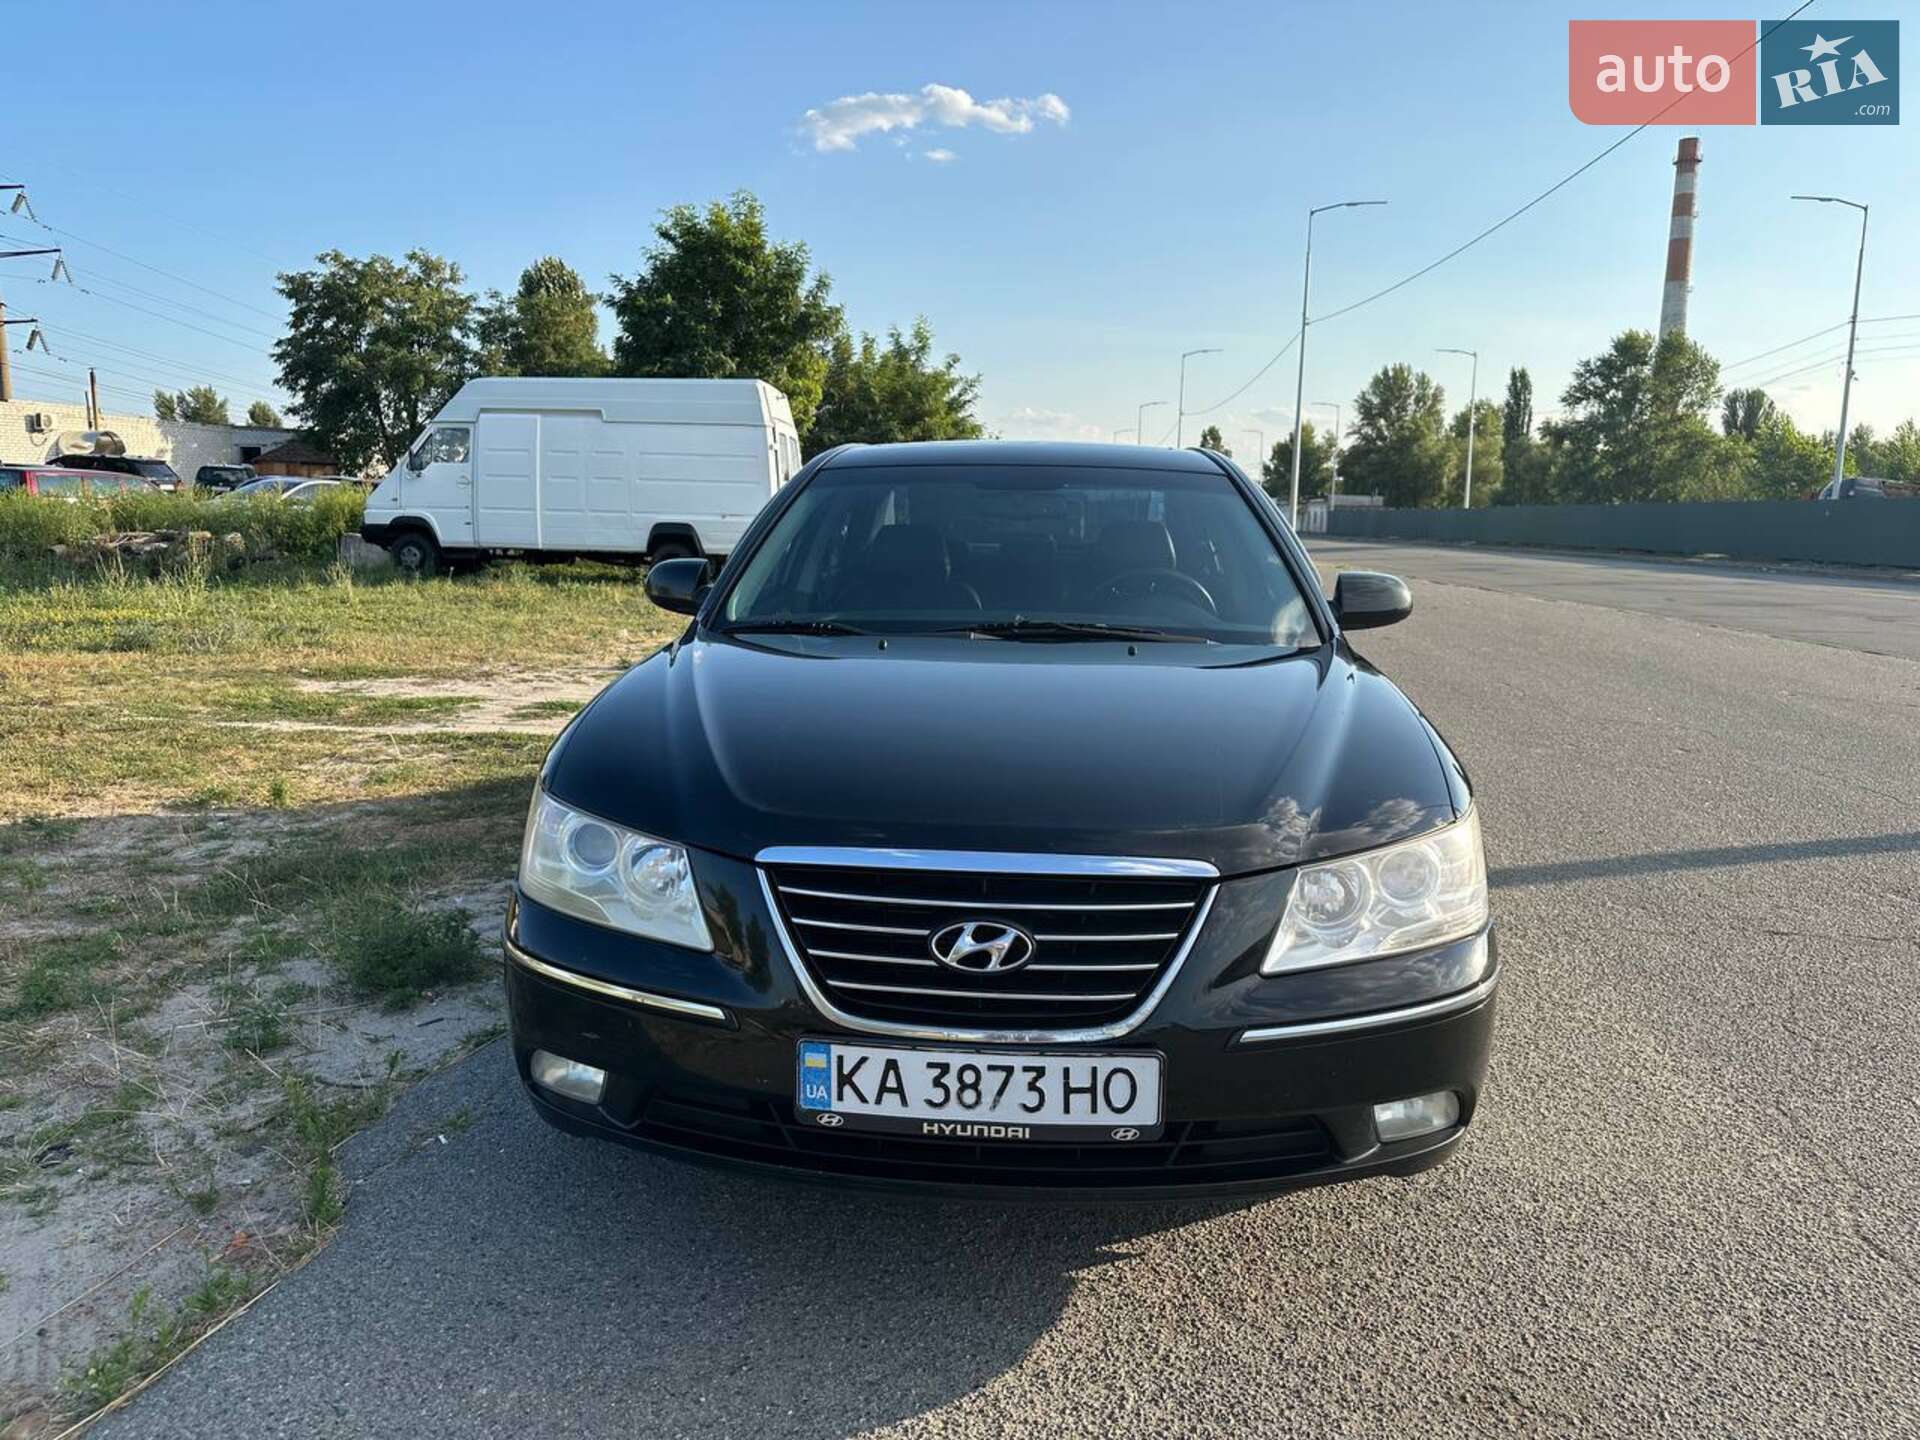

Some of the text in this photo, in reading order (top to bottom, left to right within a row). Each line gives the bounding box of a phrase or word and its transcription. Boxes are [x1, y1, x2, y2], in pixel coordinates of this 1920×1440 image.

[805, 1083, 828, 1100] UA
[835, 1054, 1138, 1114] KA 3873 HO
[922, 1122, 1030, 1139] HYUNDAI
